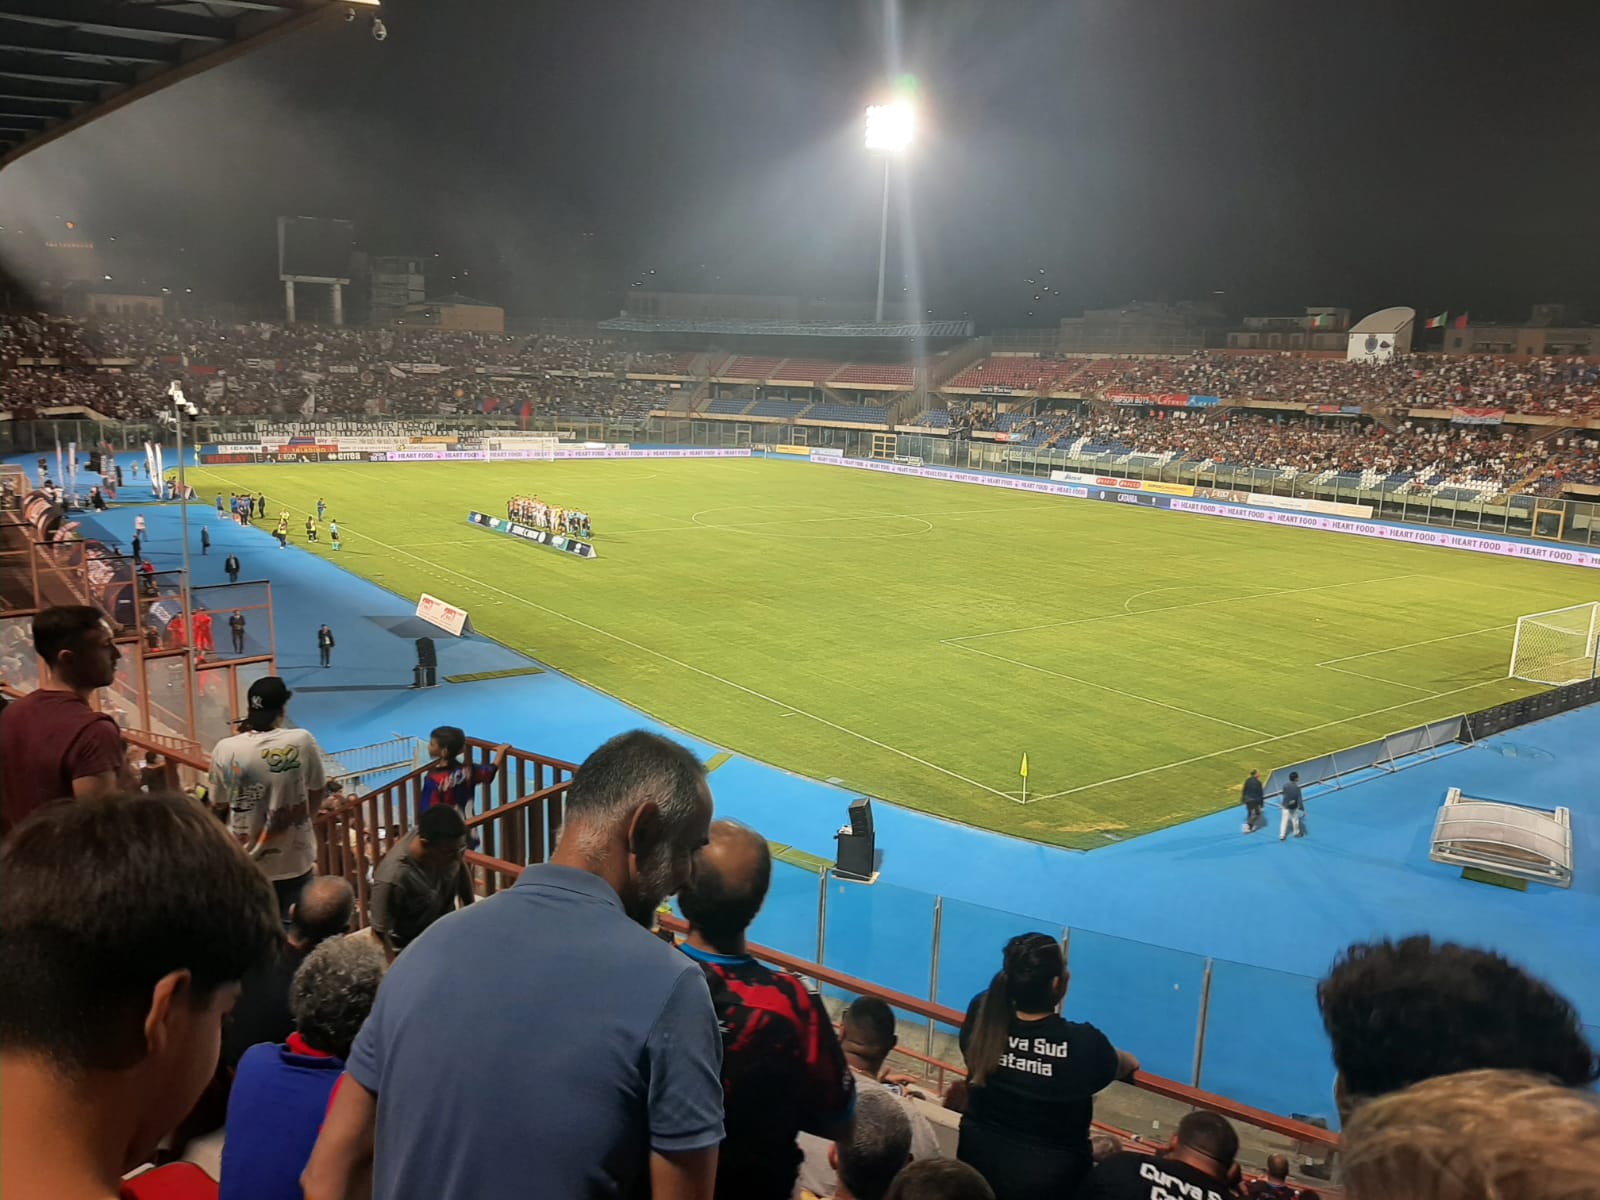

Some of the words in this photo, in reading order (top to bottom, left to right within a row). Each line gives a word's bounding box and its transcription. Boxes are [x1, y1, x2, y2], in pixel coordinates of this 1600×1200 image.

[1181, 501, 1199, 511] HEART
[1200, 503, 1216, 512] FOOD
[1227, 508, 1247, 517] HEART
[1248, 510, 1265, 519] FOOD
[1277, 514, 1298, 524] HEART
[1299, 517, 1317, 526] FOOD
[1332, 521, 1354, 531] HEART
[1355, 524, 1375, 534] FOOD
[1389, 528, 1414, 539] HEART
[1415, 531, 1436, 542] FOOD
[1451, 536, 1477, 548] HEART
[1478, 540, 1502, 551] FOOD
[1519, 546, 1548, 558] HEART
[1549, 549, 1573, 561] FOOD
[1008, 1036, 1029, 1051] va
[1033, 1038, 1068, 1058] Sud
[1000, 1053, 1053, 1077] atania
[1140, 1162, 1203, 1200] Curva
